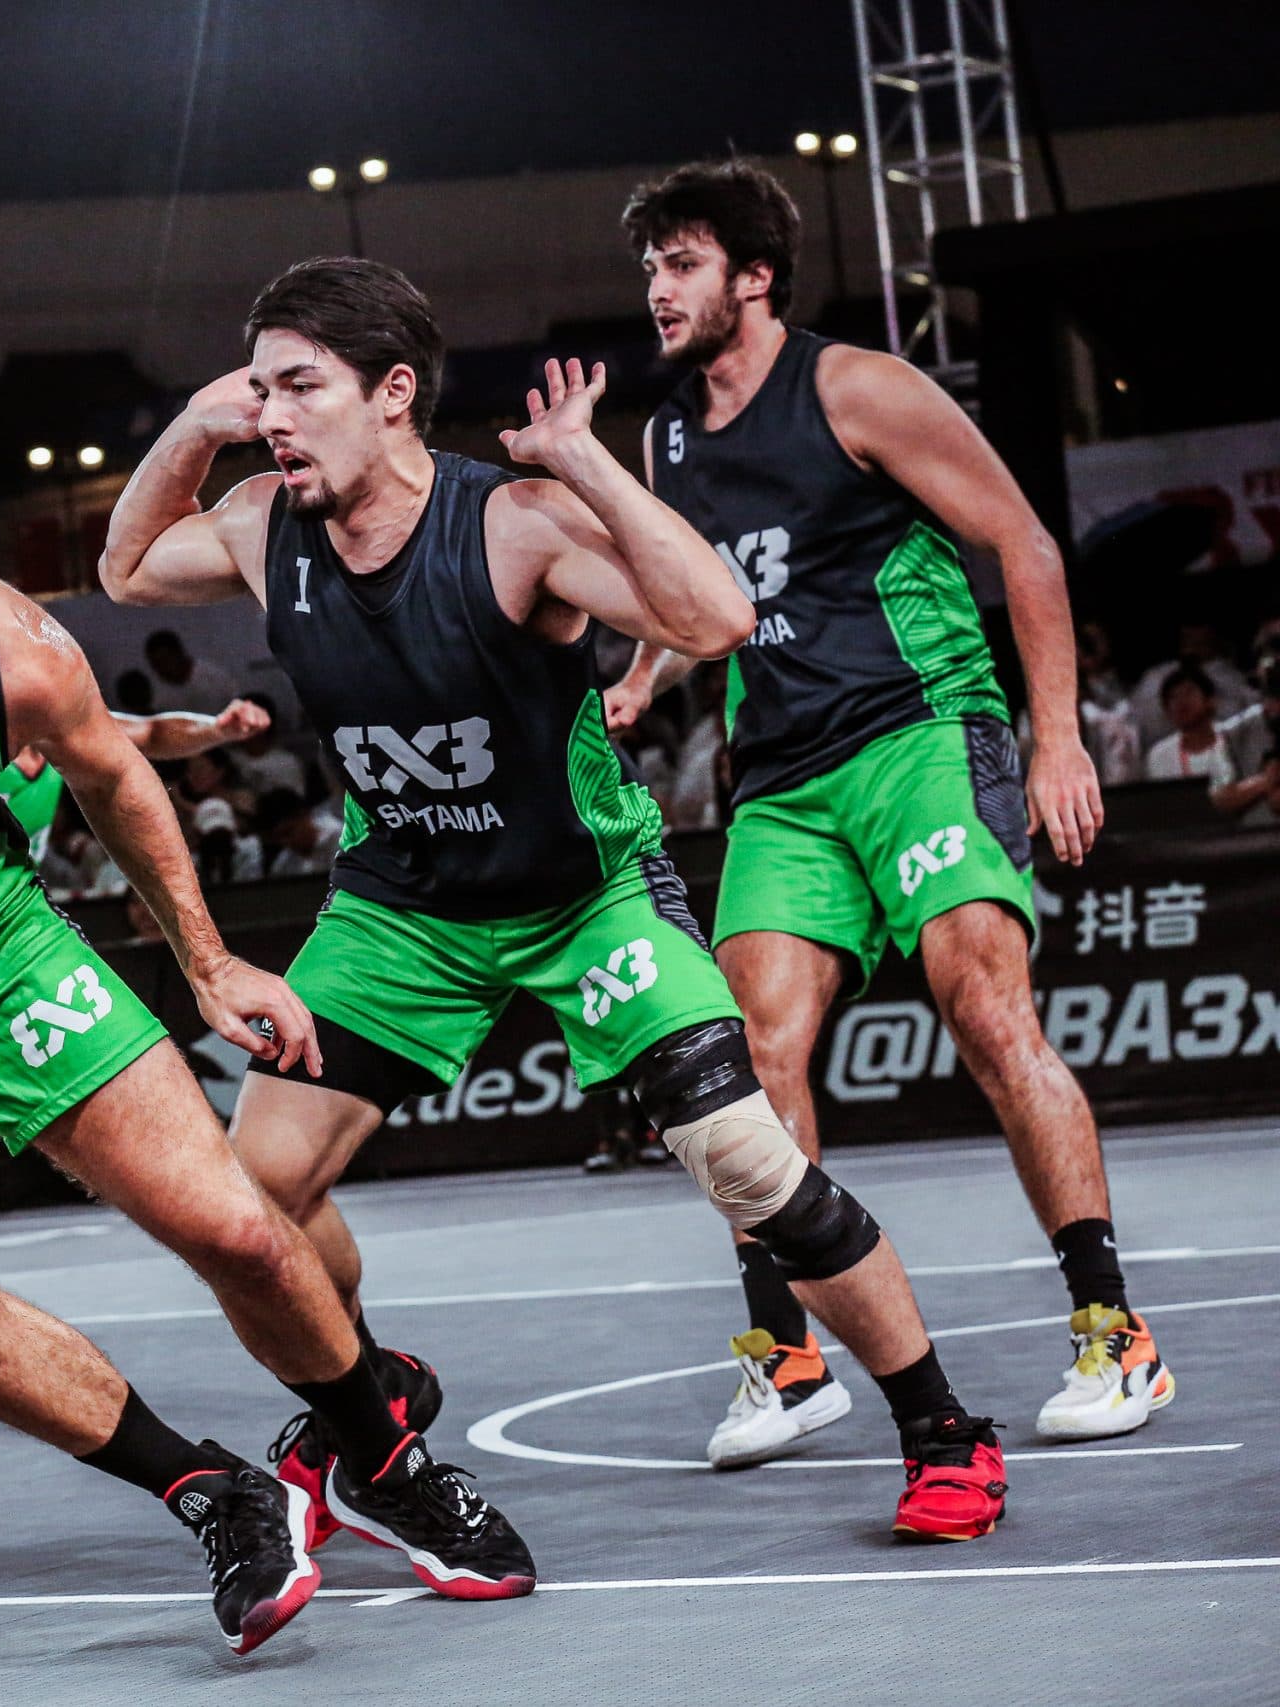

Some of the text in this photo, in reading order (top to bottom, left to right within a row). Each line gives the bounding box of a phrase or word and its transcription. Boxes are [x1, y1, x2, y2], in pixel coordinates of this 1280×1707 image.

[668, 419, 685, 465] 5
[293, 556, 312, 614] 1
[1075, 882, 1208, 954] 抖音
